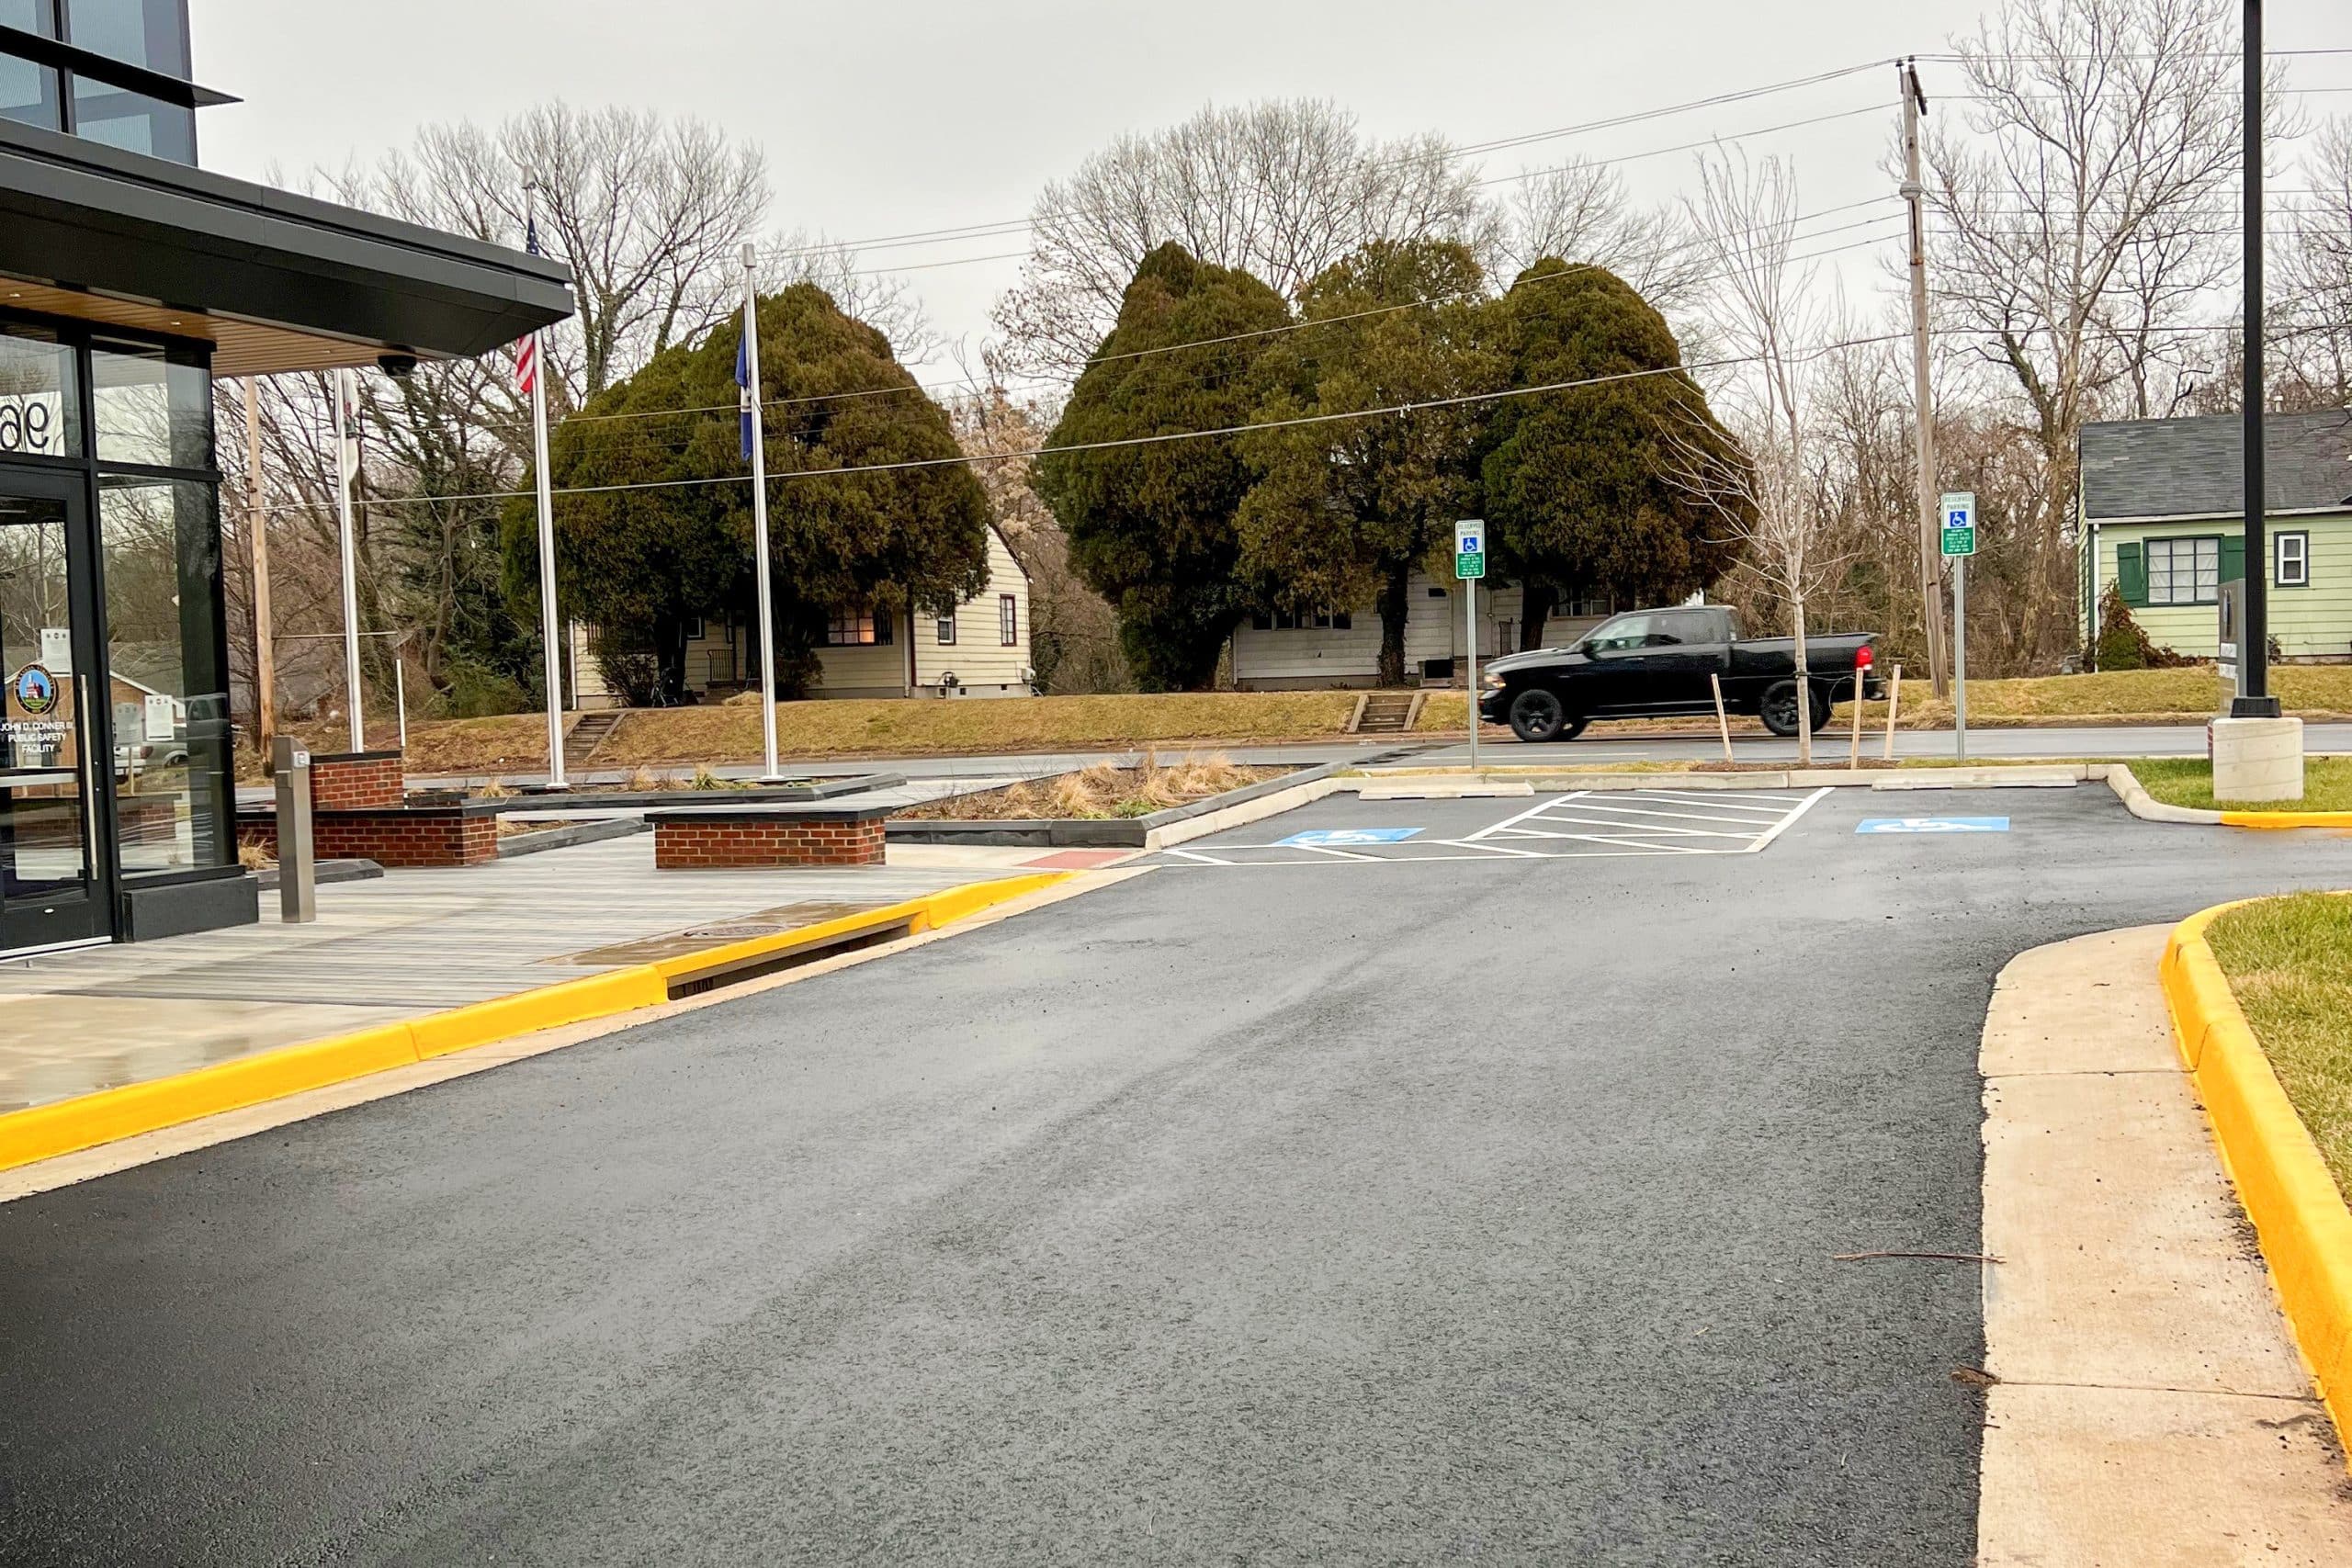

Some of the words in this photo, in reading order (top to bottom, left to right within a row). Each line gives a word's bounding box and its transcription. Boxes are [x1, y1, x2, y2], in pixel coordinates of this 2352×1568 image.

[1, 722, 21, 731] JOHN
[33, 721, 65, 730] CONNER
[8, 734, 37, 742] PUBLIC
[39, 732, 66, 741] SAFETY
[22, 744, 55, 753] FACILITY
